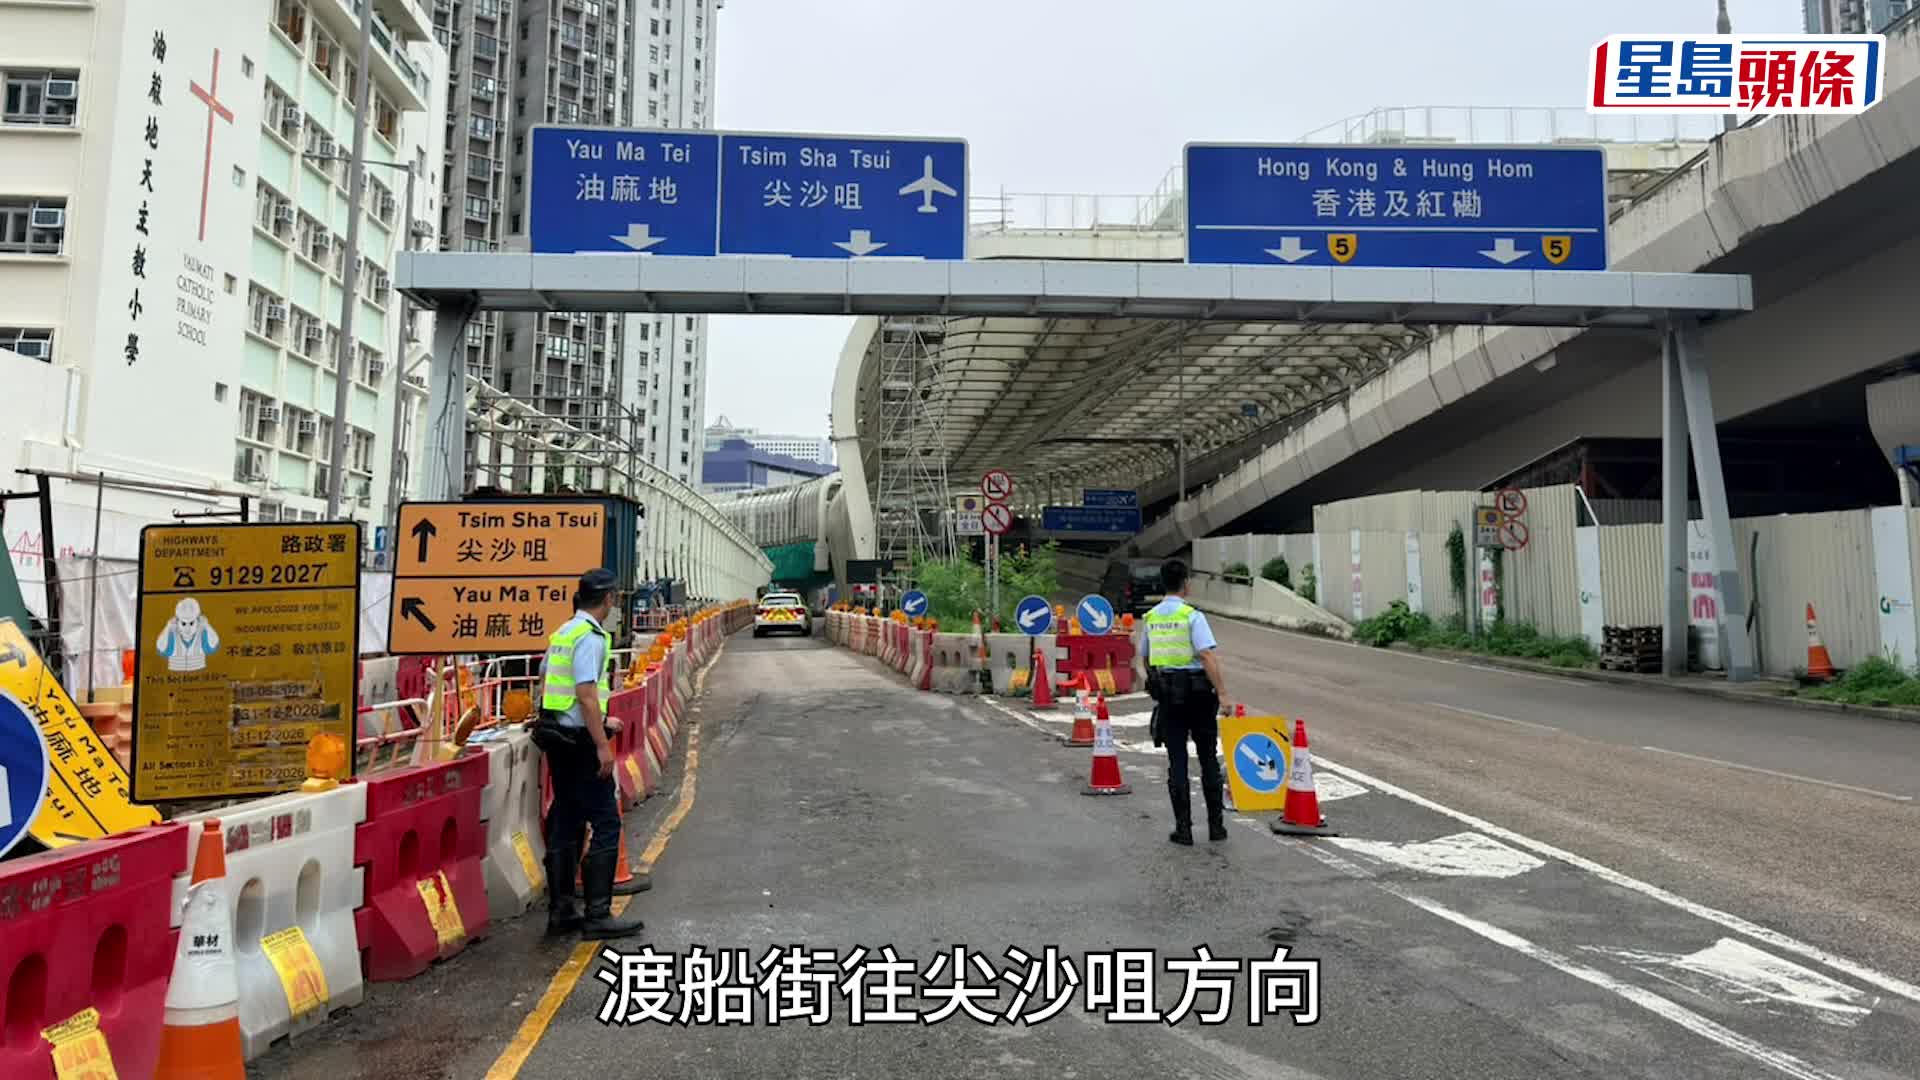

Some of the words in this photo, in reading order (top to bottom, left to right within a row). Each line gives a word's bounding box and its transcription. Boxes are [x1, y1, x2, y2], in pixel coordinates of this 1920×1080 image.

[566, 139, 603, 160] Yau
[616, 141, 645, 161] Ma
[661, 143, 691, 163] Tei
[739, 145, 787, 167] Tsim
[800, 147, 837, 168] Sha
[850, 149, 891, 169] Tsui
[1258, 158, 1310, 180] Hong
[1326, 158, 1378, 181] Kong
[1393, 159, 1407, 177] &
[1422, 159, 1474, 181] Hung
[1488, 159, 1533, 178] Hom
[575, 173, 679, 205] 油麻地
[763, 180, 863, 210] 尖沙咀
[1312, 189, 1483, 219] 香港及紅磡
[1335, 238, 1349, 256] 5
[1550, 241, 1563, 258] 5
[458, 512, 505, 528] Tsim
[512, 512, 550, 528] Sha
[556, 511, 598, 528] Tsui
[163, 535, 219, 545] HIGHWAYS
[281, 533, 346, 554] 路政署
[457, 538, 548, 562] 尖沙咀
[155, 548, 226, 559] DEPARTMENT
[210, 565, 264, 585] 9129
[271, 562, 328, 583] 2027
[453, 586, 491, 603] Yau
[499, 585, 529, 602] Ma
[536, 585, 567, 602] Tei
[452, 613, 544, 638] 油麻地
[46, 688, 76, 729] Yau
[79, 735, 104, 768] Ma
